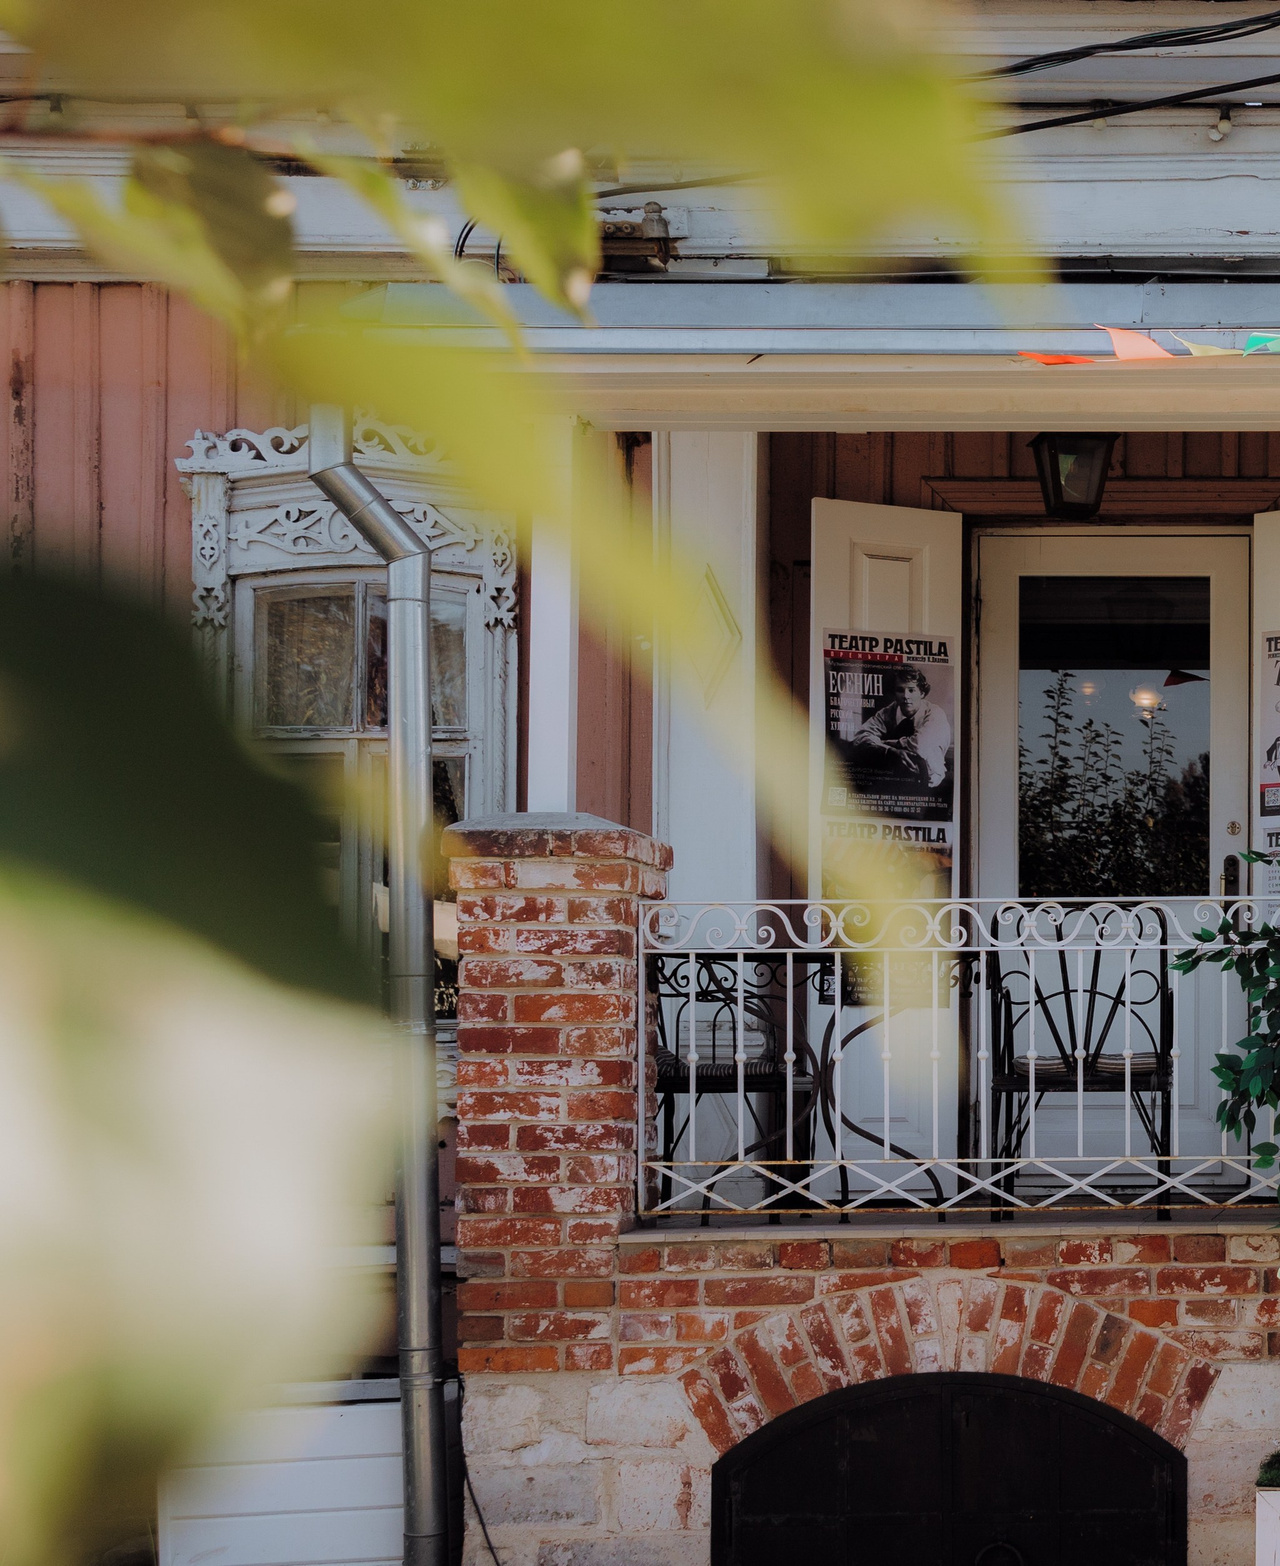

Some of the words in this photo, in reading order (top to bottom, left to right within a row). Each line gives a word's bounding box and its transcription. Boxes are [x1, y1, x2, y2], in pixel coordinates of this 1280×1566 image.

[828, 634, 879, 652] ТЕАТР
[883, 638, 949, 657] PASTILA
[830, 651, 899, 661] ПРЕМЬЕРА
[829, 671, 883, 696] ЕСЕНИН
[827, 821, 877, 839] ТЕАТР
[882, 824, 947, 843] PASTILA
